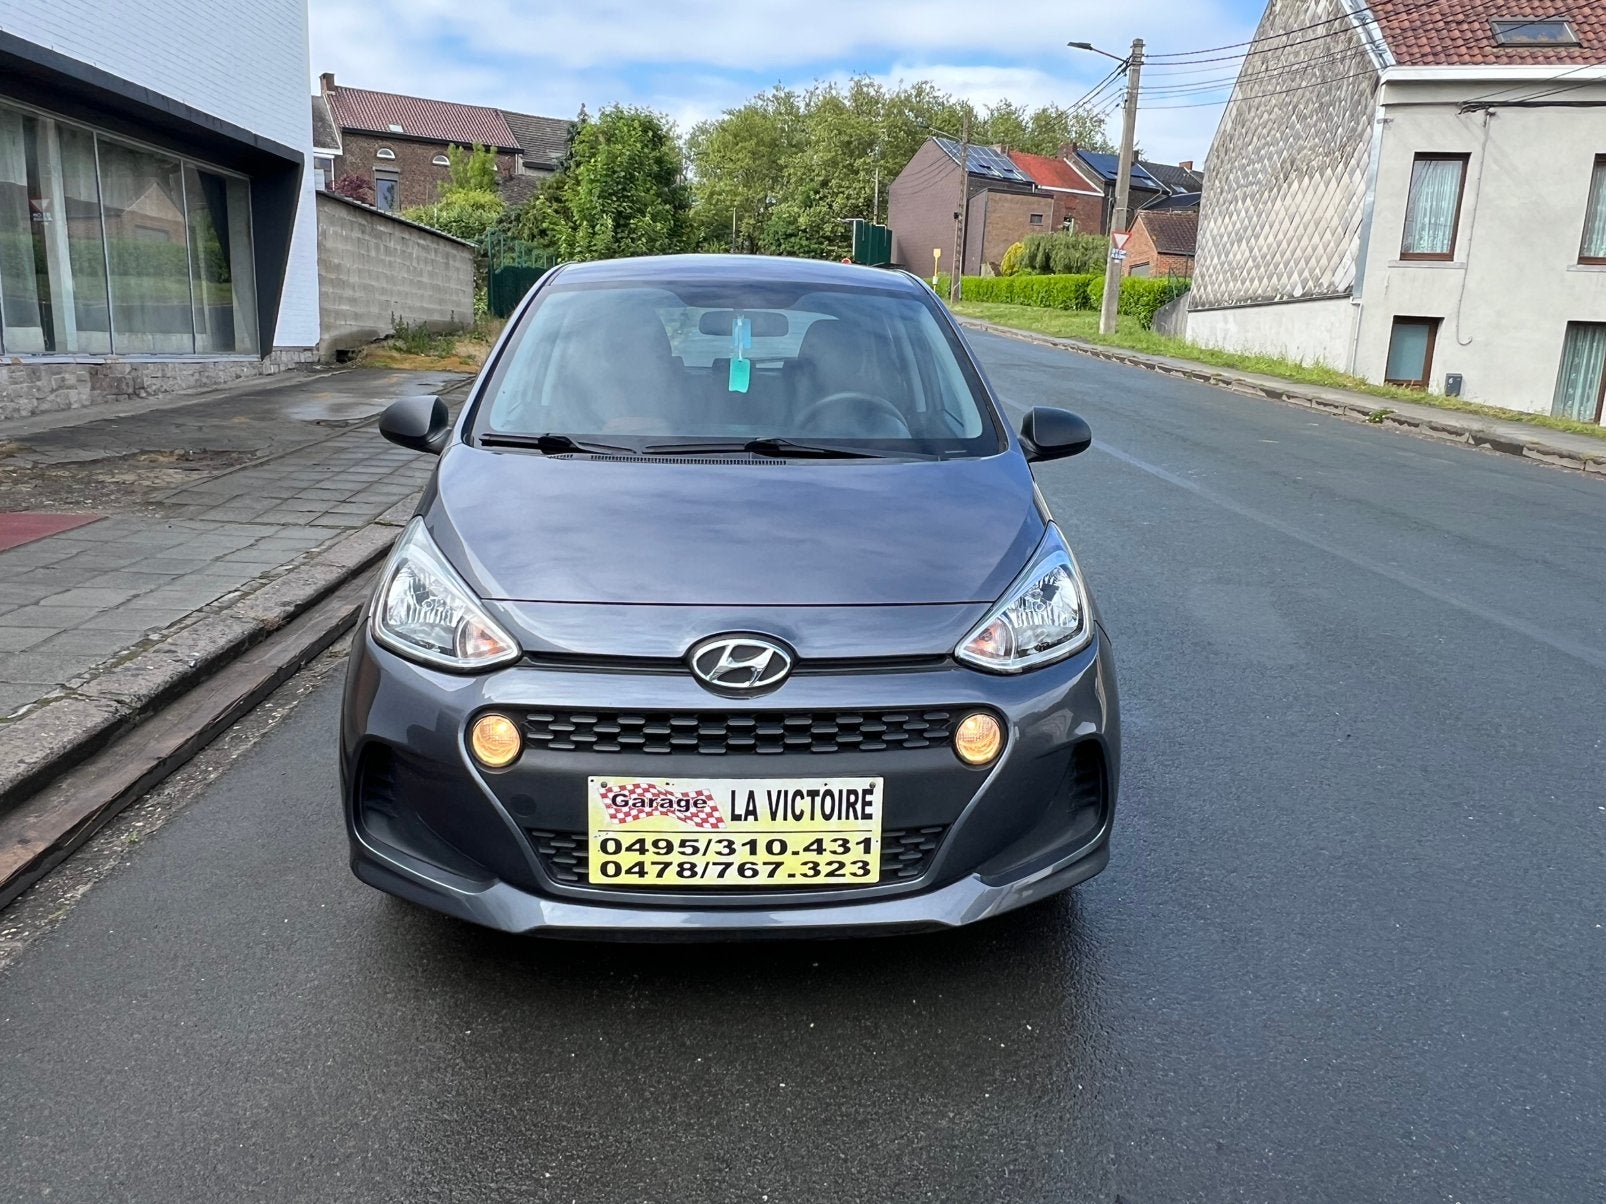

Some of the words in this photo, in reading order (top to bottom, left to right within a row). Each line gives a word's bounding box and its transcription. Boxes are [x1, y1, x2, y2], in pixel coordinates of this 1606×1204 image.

[611, 793, 708, 813] Garage
[730, 789, 759, 822] LA
[766, 789, 874, 822] VICTOIRE
[599, 837, 872, 856] 0495/310.431
[599, 860, 872, 879] 0478/767.323
